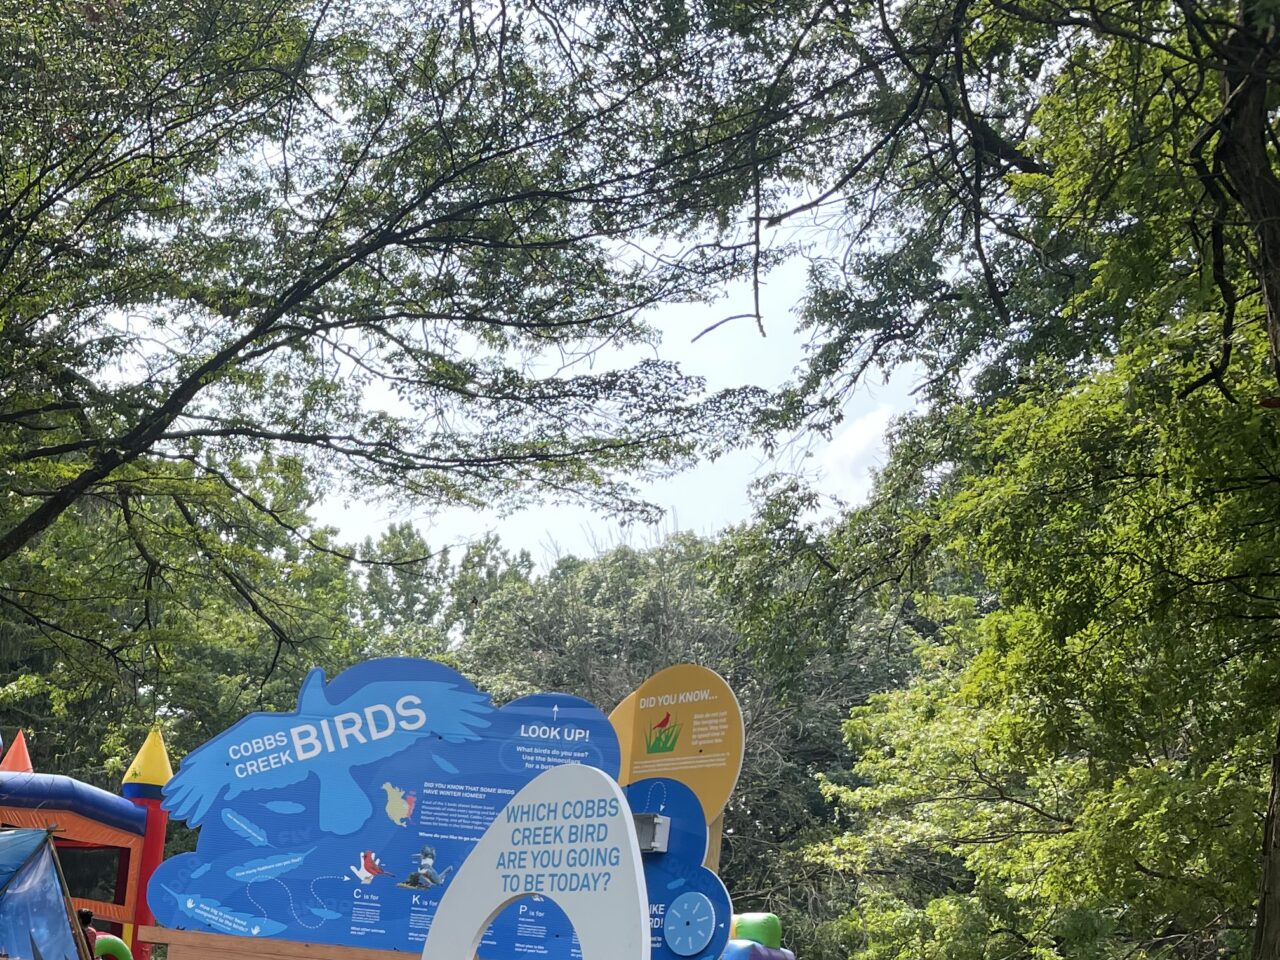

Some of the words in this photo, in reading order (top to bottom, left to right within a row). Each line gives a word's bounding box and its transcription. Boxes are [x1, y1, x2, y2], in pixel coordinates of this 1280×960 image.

[640, 698, 656, 709] DID
[658, 694, 677, 706] YOU
[290, 694, 427, 761] BIRDS
[520, 725, 560, 740] LOOK
[564, 728, 590, 742] UP!
[228, 731, 288, 760] COBBS
[534, 747, 551, 755] birds
[234, 750, 294, 778] CREEK
[506, 802, 558, 823] WHICH
[562, 798, 619, 820] COBBS
[511, 825, 564, 846] CREEK
[568, 823, 608, 843] BIRD
[496, 851, 528, 869] ARE
[531, 849, 562, 868] YOU
[566, 847, 620, 867] GOING
[501, 874, 519, 892] TO
[524, 873, 545, 892] BE
[548, 872, 611, 892] TODAY?
[353, 888, 361, 899] C
[412, 894, 420, 905] K
[519, 904, 528, 915] P
[649, 904, 665, 915] IKE
[649, 917, 664, 929] RD!
